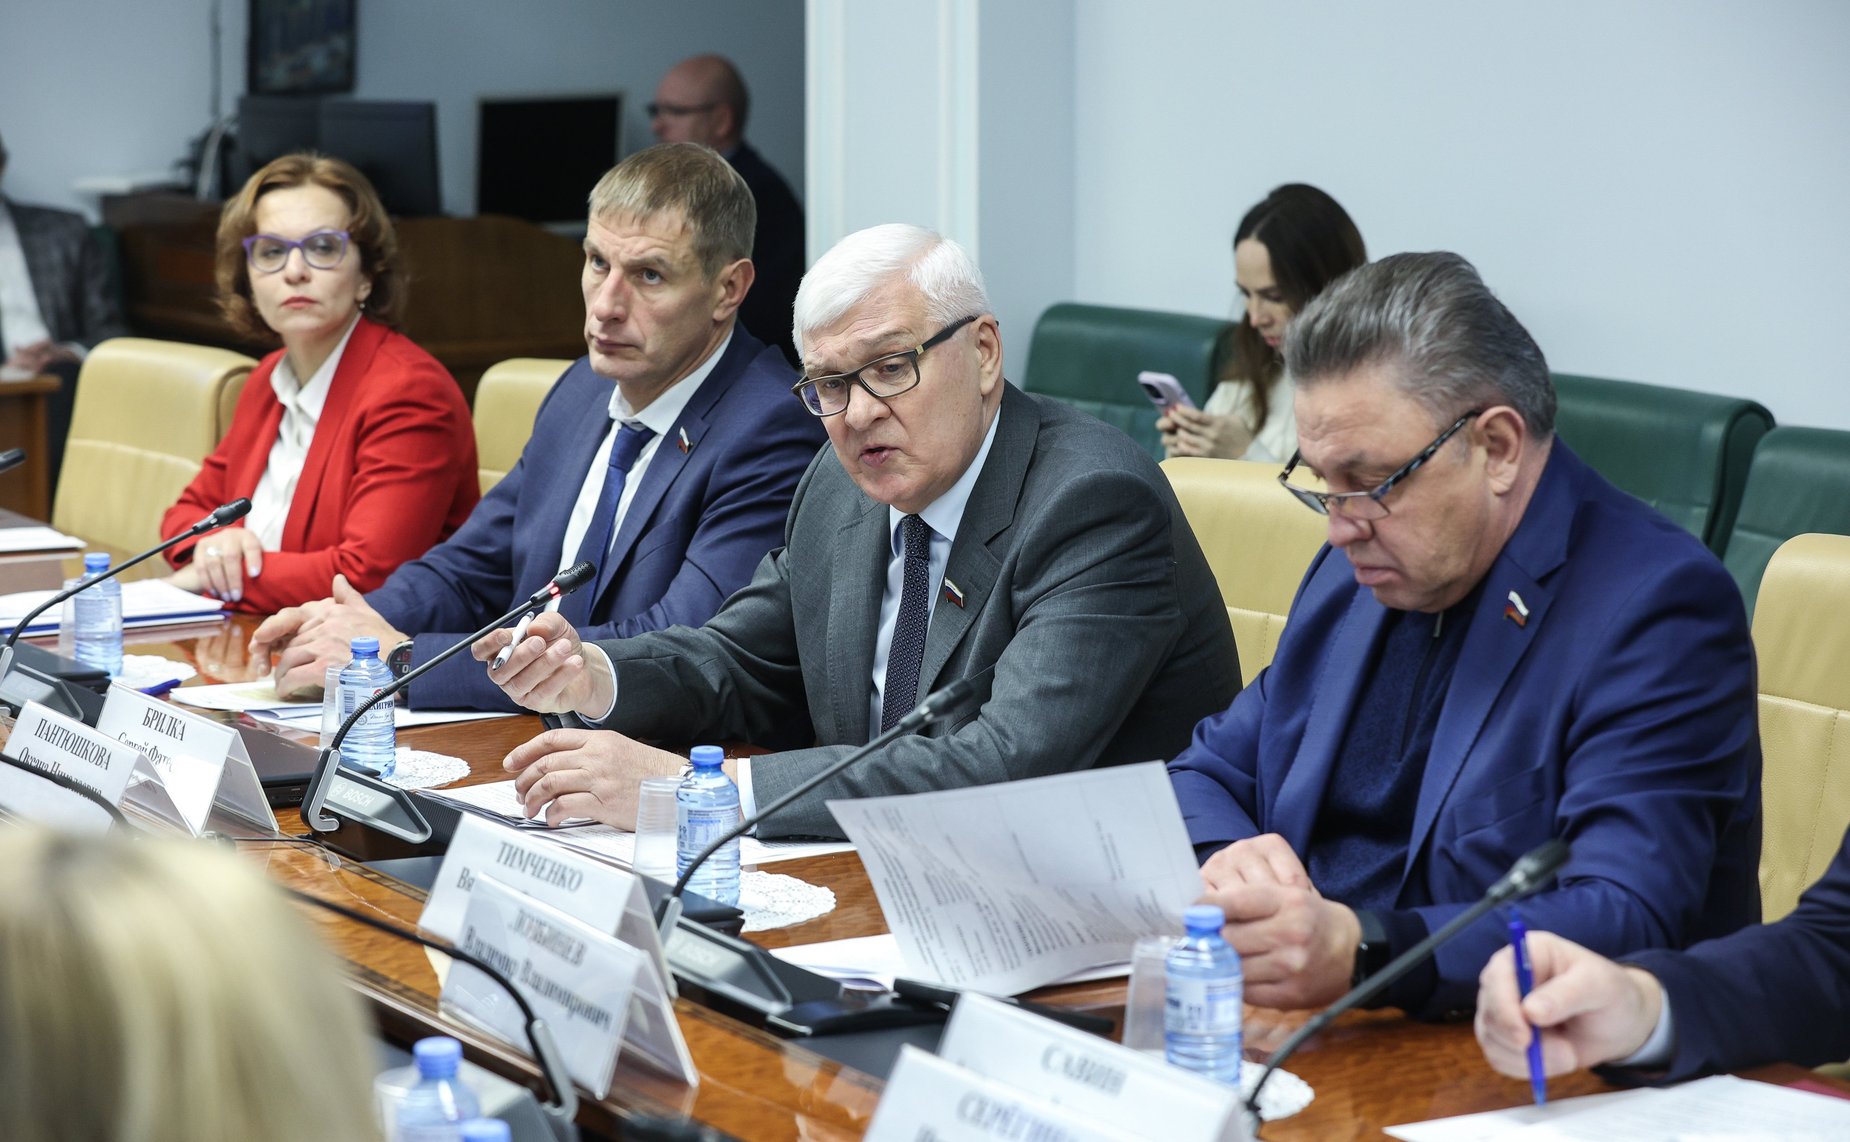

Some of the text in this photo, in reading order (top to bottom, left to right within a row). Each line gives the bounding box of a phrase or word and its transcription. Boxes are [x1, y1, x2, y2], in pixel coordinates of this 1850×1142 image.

[33, 718, 112, 771] ПАНТЮШКОВА
[142, 706, 186, 741] БРИЛКА
[495, 841, 585, 893] ТИМЧЕНКО
